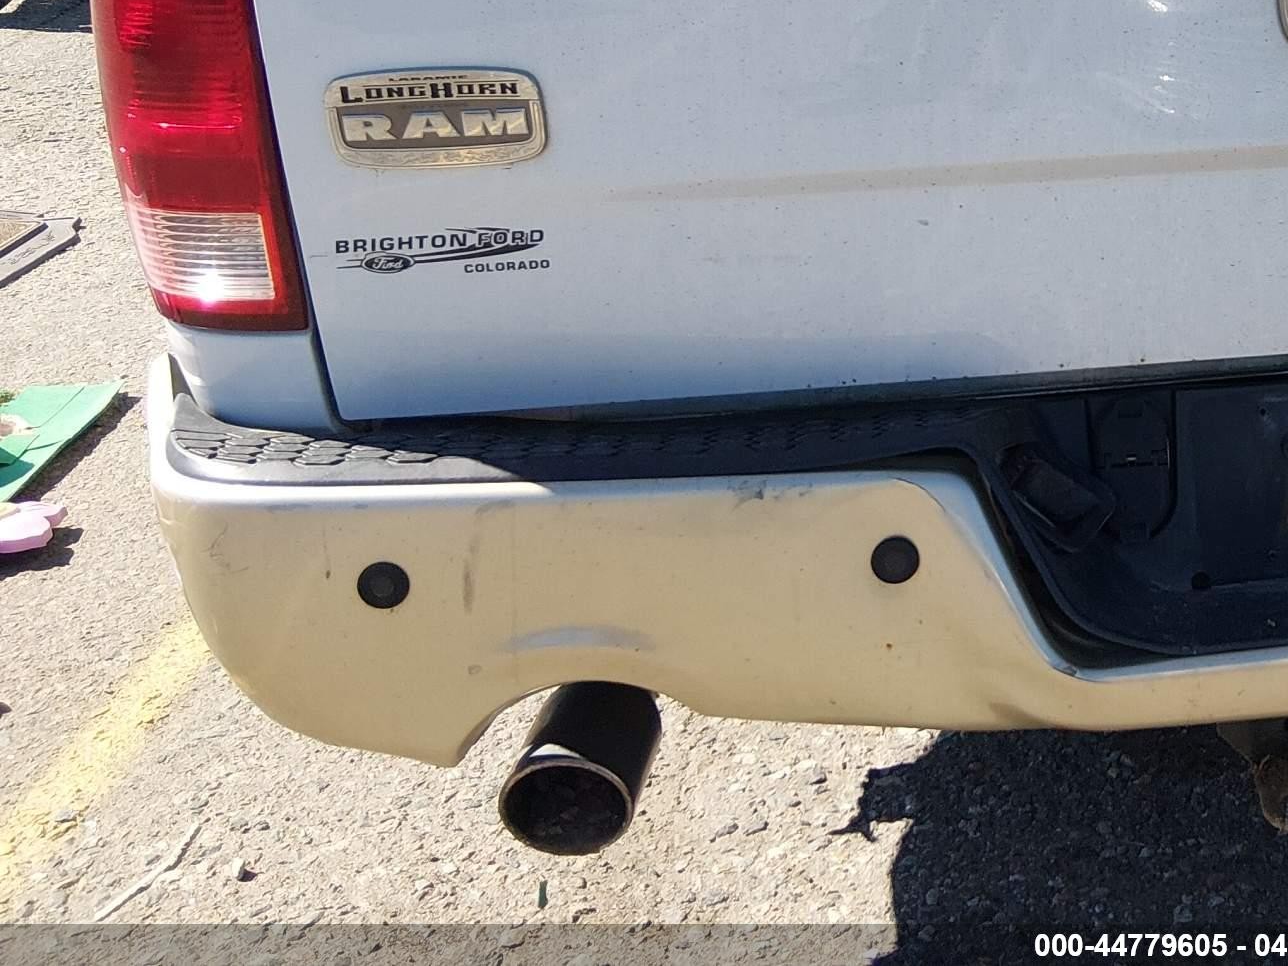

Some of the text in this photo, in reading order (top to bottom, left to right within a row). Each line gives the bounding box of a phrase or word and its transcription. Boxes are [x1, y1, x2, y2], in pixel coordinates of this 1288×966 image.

[342, 108, 529, 141] RAM
[335, 229, 544, 254] BRIGHTON FORD
[371, 256, 404, 270] Ford
[464, 259, 550, 274] COLORADO
